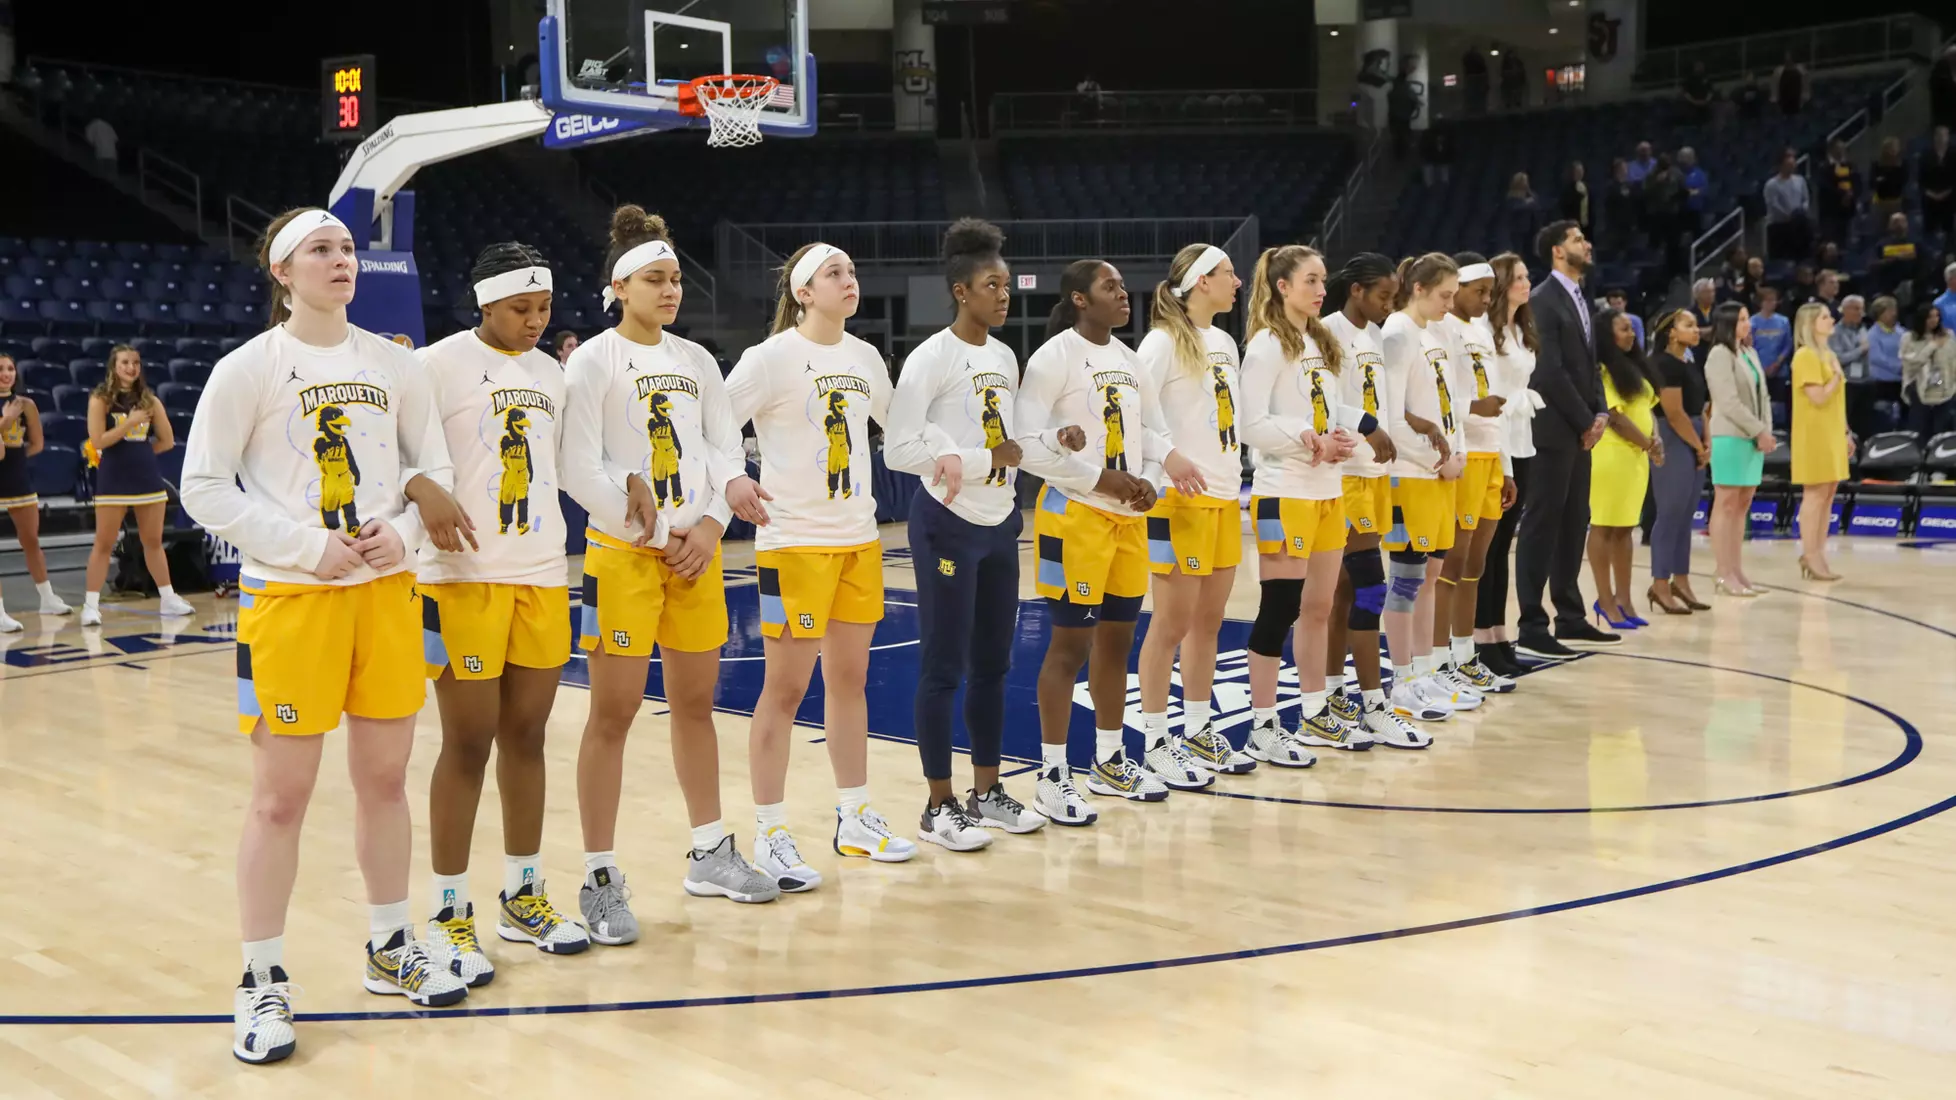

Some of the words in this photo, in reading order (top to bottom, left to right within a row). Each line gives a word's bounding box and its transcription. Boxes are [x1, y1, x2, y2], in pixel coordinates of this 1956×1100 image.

[338, 95, 359, 128] 30
[362, 124, 394, 159] SPALDING
[360, 259, 408, 274] SPALDING
[637, 375, 698, 400] MARQUETTE
[815, 375, 870, 398] MARQUETTE
[300, 382, 388, 417] MARQUETTE
[1852, 516, 1898, 528] GEICO
[938, 558, 956, 577] MU
[1186, 556, 1200, 570] MU
[1076, 582, 1090, 596] MU
[799, 613, 814, 630] MU
[612, 630, 631, 648] MU
[463, 655, 484, 674] MU
[276, 704, 298, 724] MU
